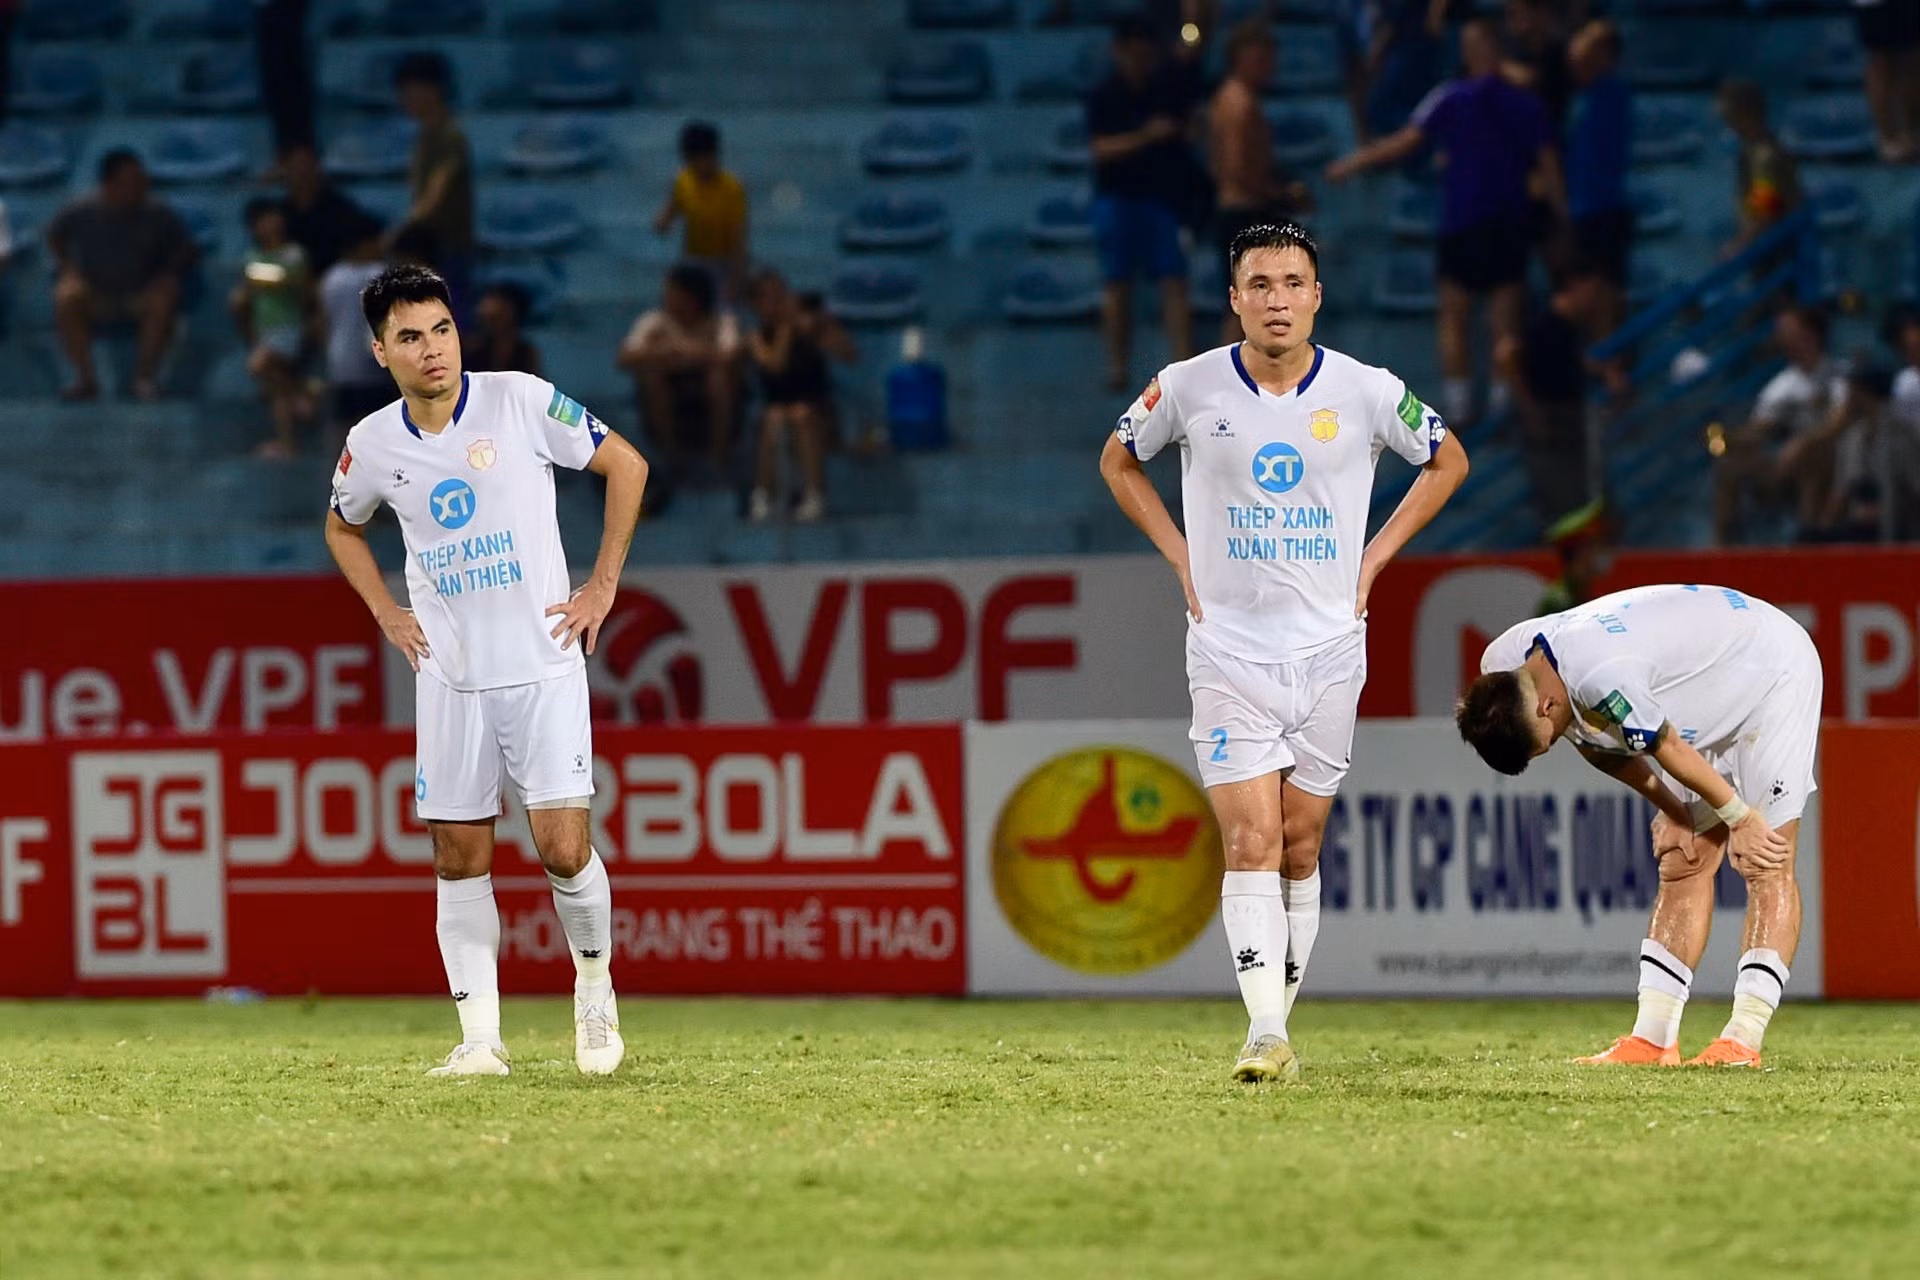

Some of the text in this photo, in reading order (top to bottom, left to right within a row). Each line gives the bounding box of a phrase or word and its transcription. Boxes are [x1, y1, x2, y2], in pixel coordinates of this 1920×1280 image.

[1258, 455, 1299, 483] XT
[433, 487, 470, 522] XT
[1227, 501, 1333, 528] THÉP XANH
[418, 530, 514, 572] THÉP XANH
[1227, 533, 1336, 565] XUÂN THIỆN
[435, 558, 522, 597] ÂN THIỆN
[725, 573, 1078, 723] VPF
[1210, 728, 1228, 762] 2
[831, 906, 956, 960] THAO
